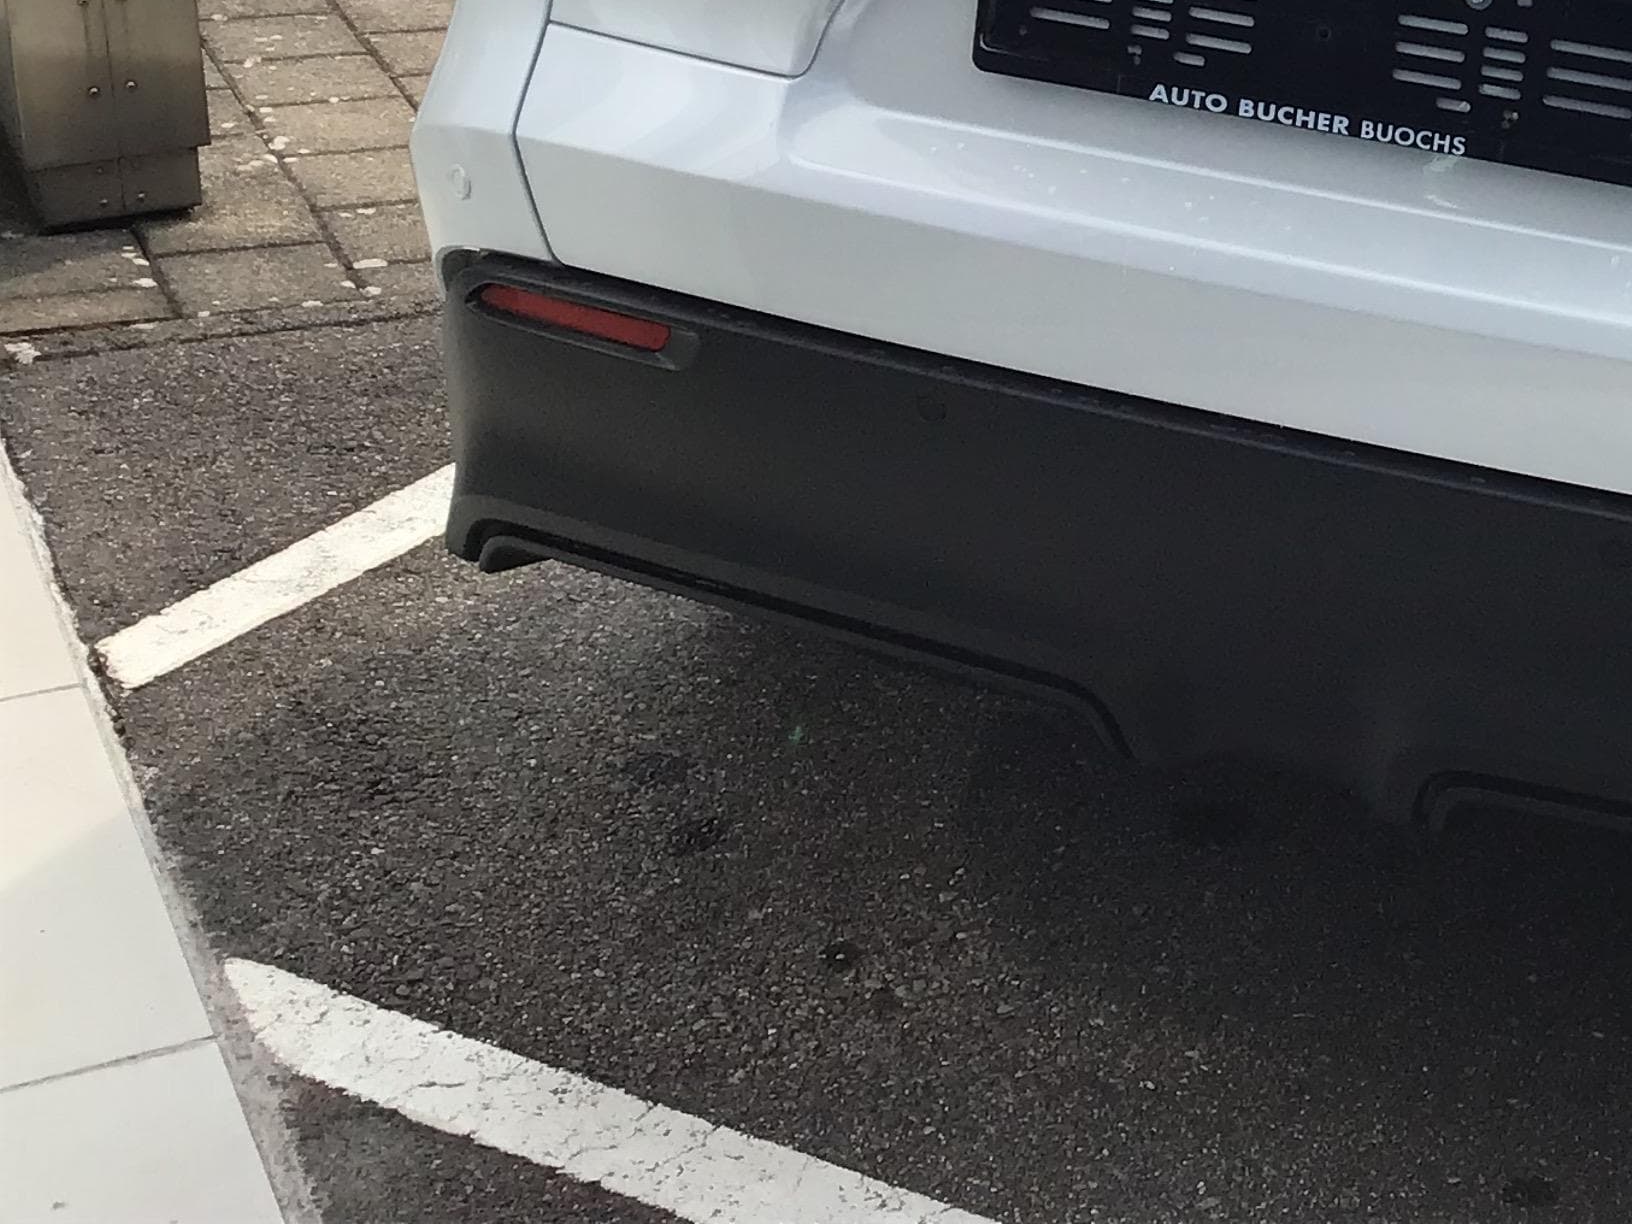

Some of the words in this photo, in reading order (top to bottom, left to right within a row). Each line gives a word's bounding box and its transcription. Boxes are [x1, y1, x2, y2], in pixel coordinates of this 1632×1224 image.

[1149, 83, 1228, 113] AUTO
[1238, 98, 1349, 136] BUCHER
[1360, 119, 1466, 155] BUOCHS
